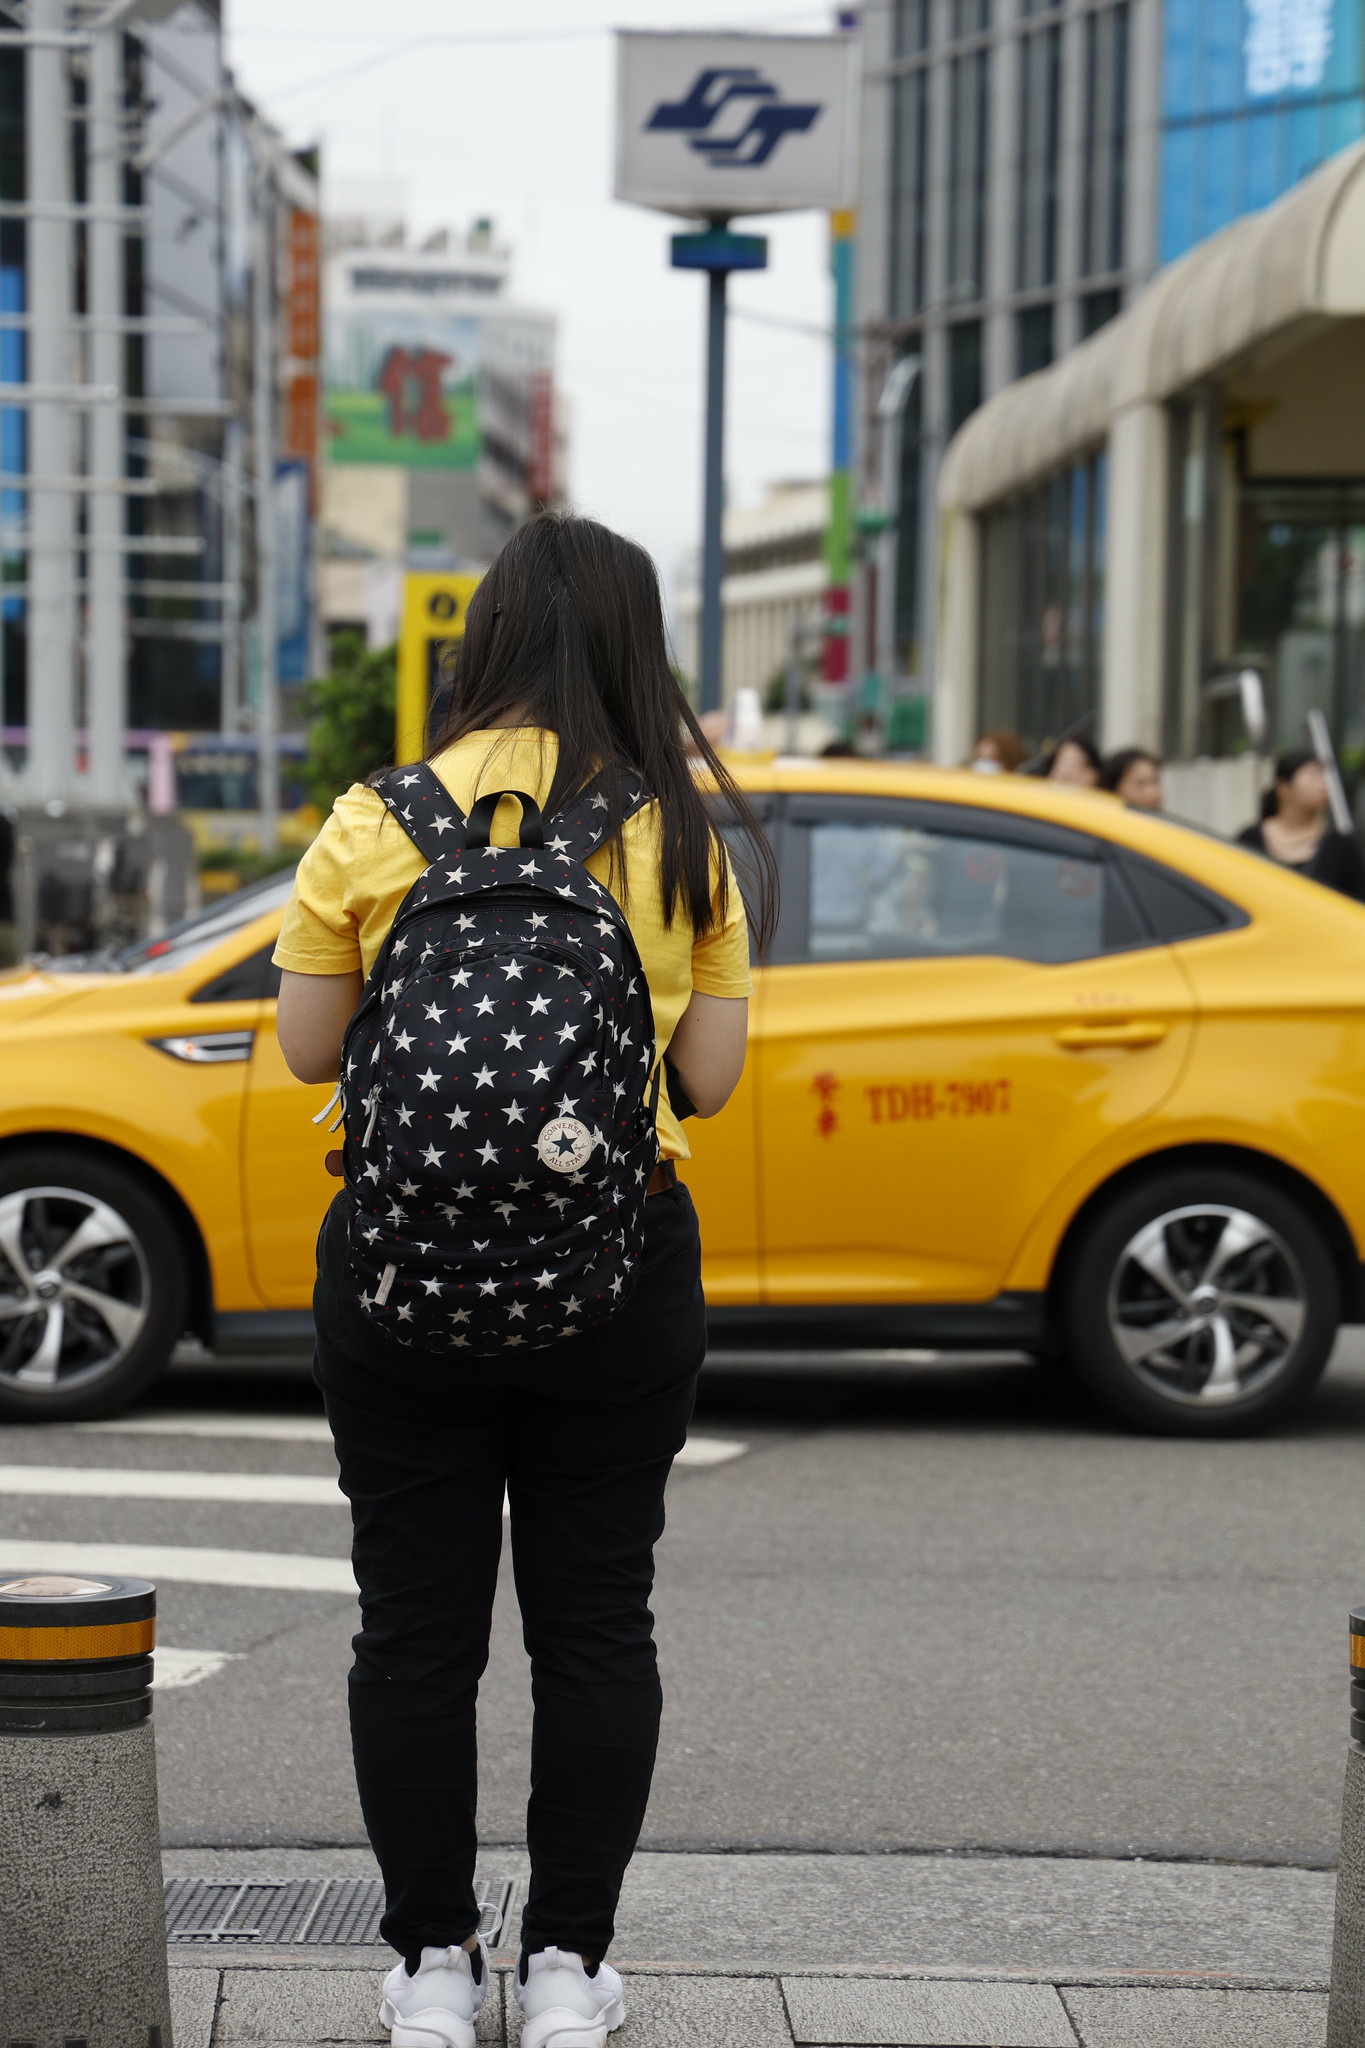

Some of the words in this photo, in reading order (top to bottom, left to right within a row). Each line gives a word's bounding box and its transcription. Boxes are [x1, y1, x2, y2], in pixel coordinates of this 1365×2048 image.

[864, 1079, 1011, 1125] TDH-7907
[543, 1122, 583, 1141] CONVERSE
[549, 1156, 563, 1167] ALL
[565, 1152, 584, 1167] STAR
